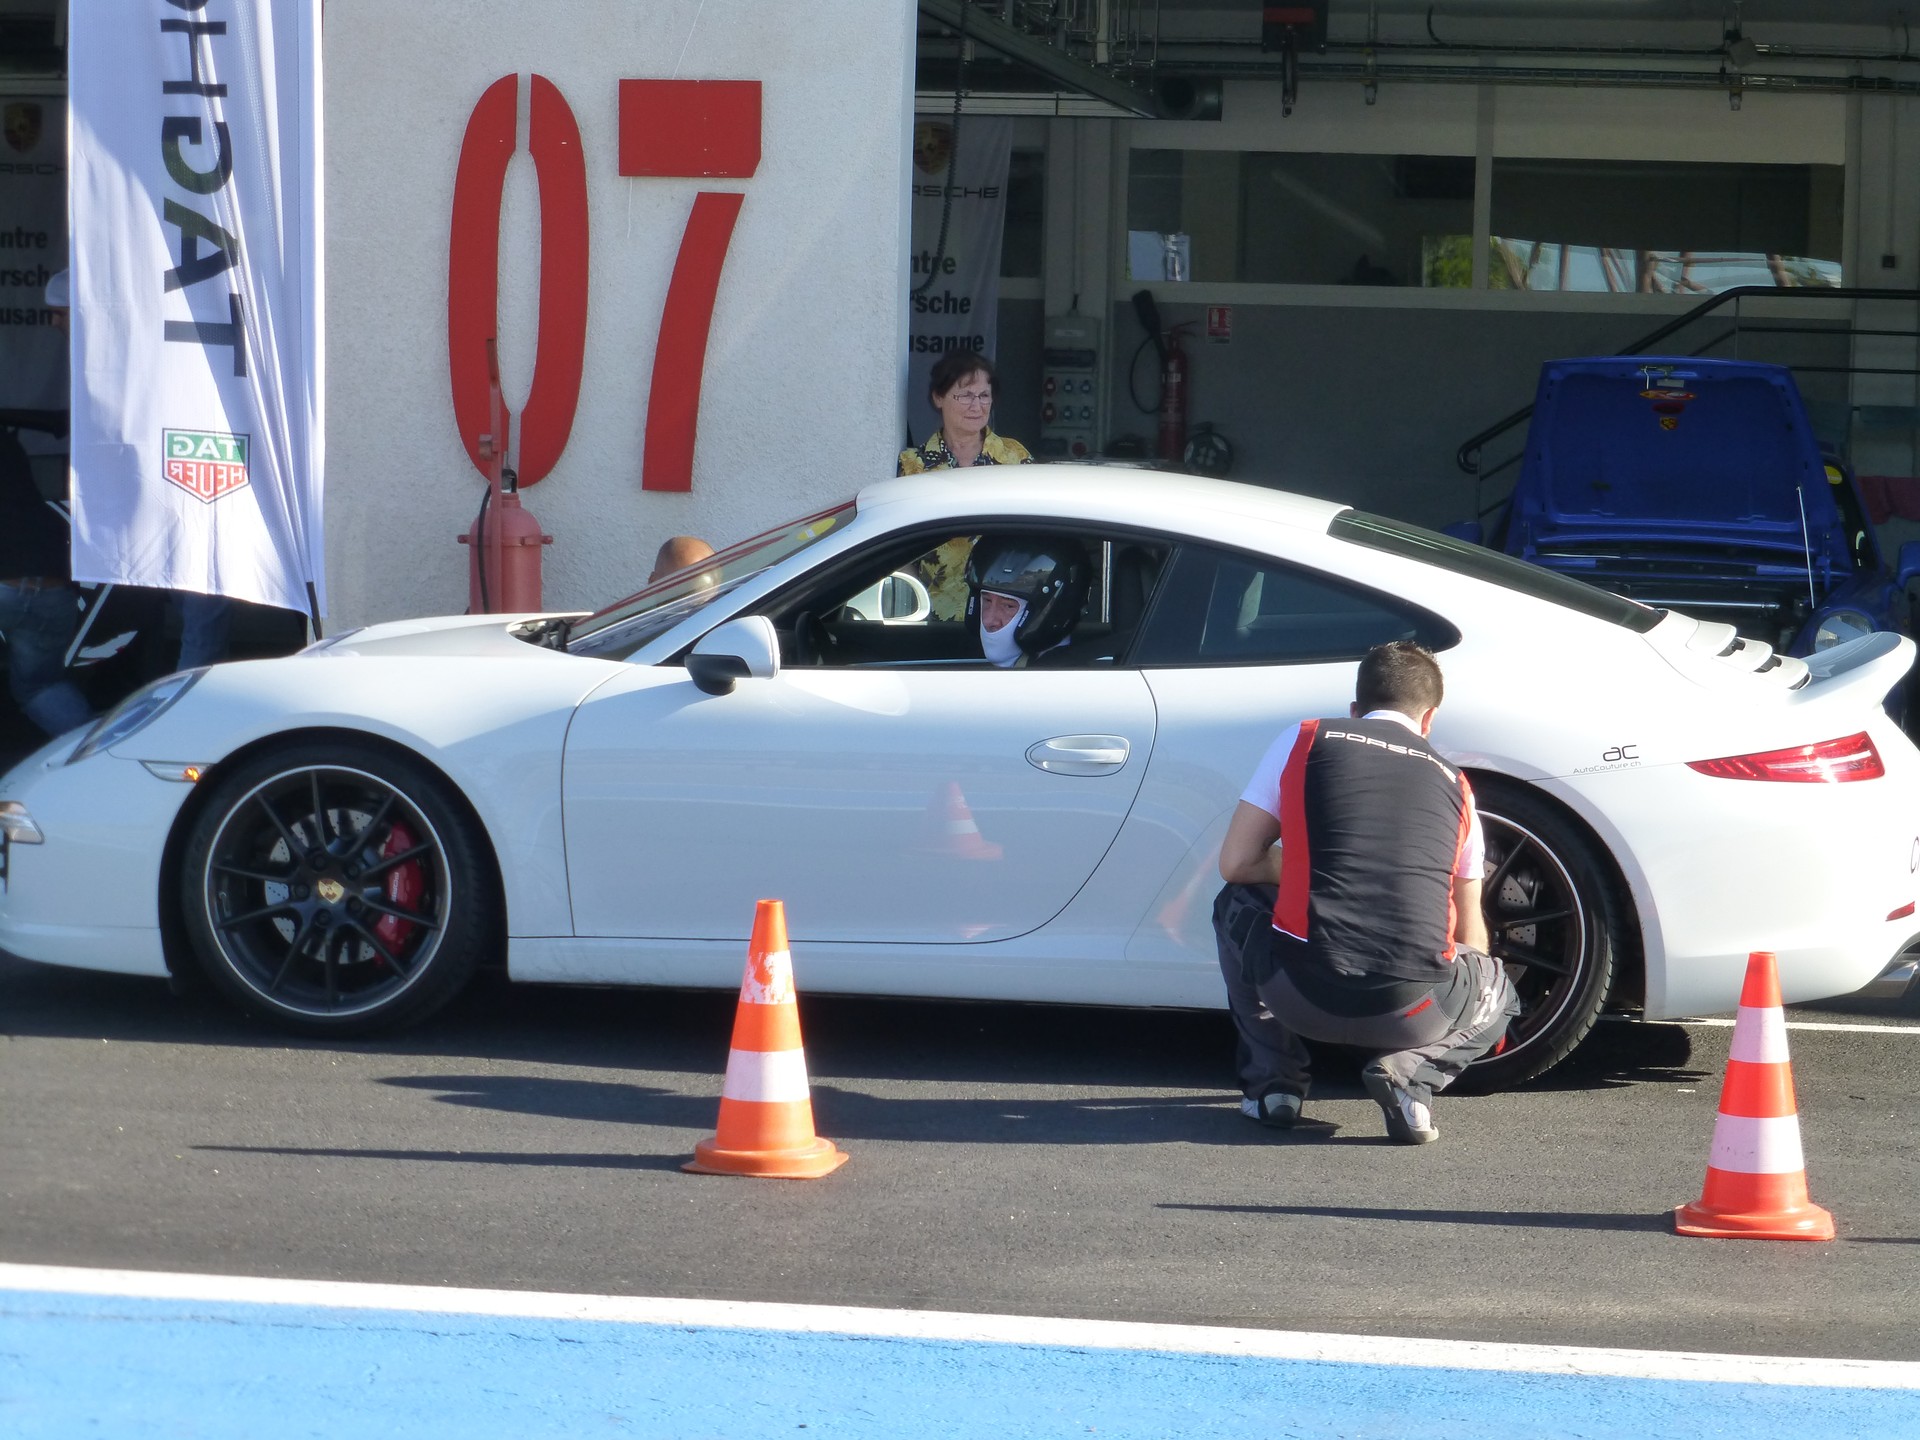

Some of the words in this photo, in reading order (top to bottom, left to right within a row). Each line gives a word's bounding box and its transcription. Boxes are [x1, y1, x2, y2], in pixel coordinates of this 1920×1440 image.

[448, 72, 761, 491] 07
[1324, 731, 1457, 784] PORSCHE
[1573, 761, 1642, 775] AutoCouture.ch
